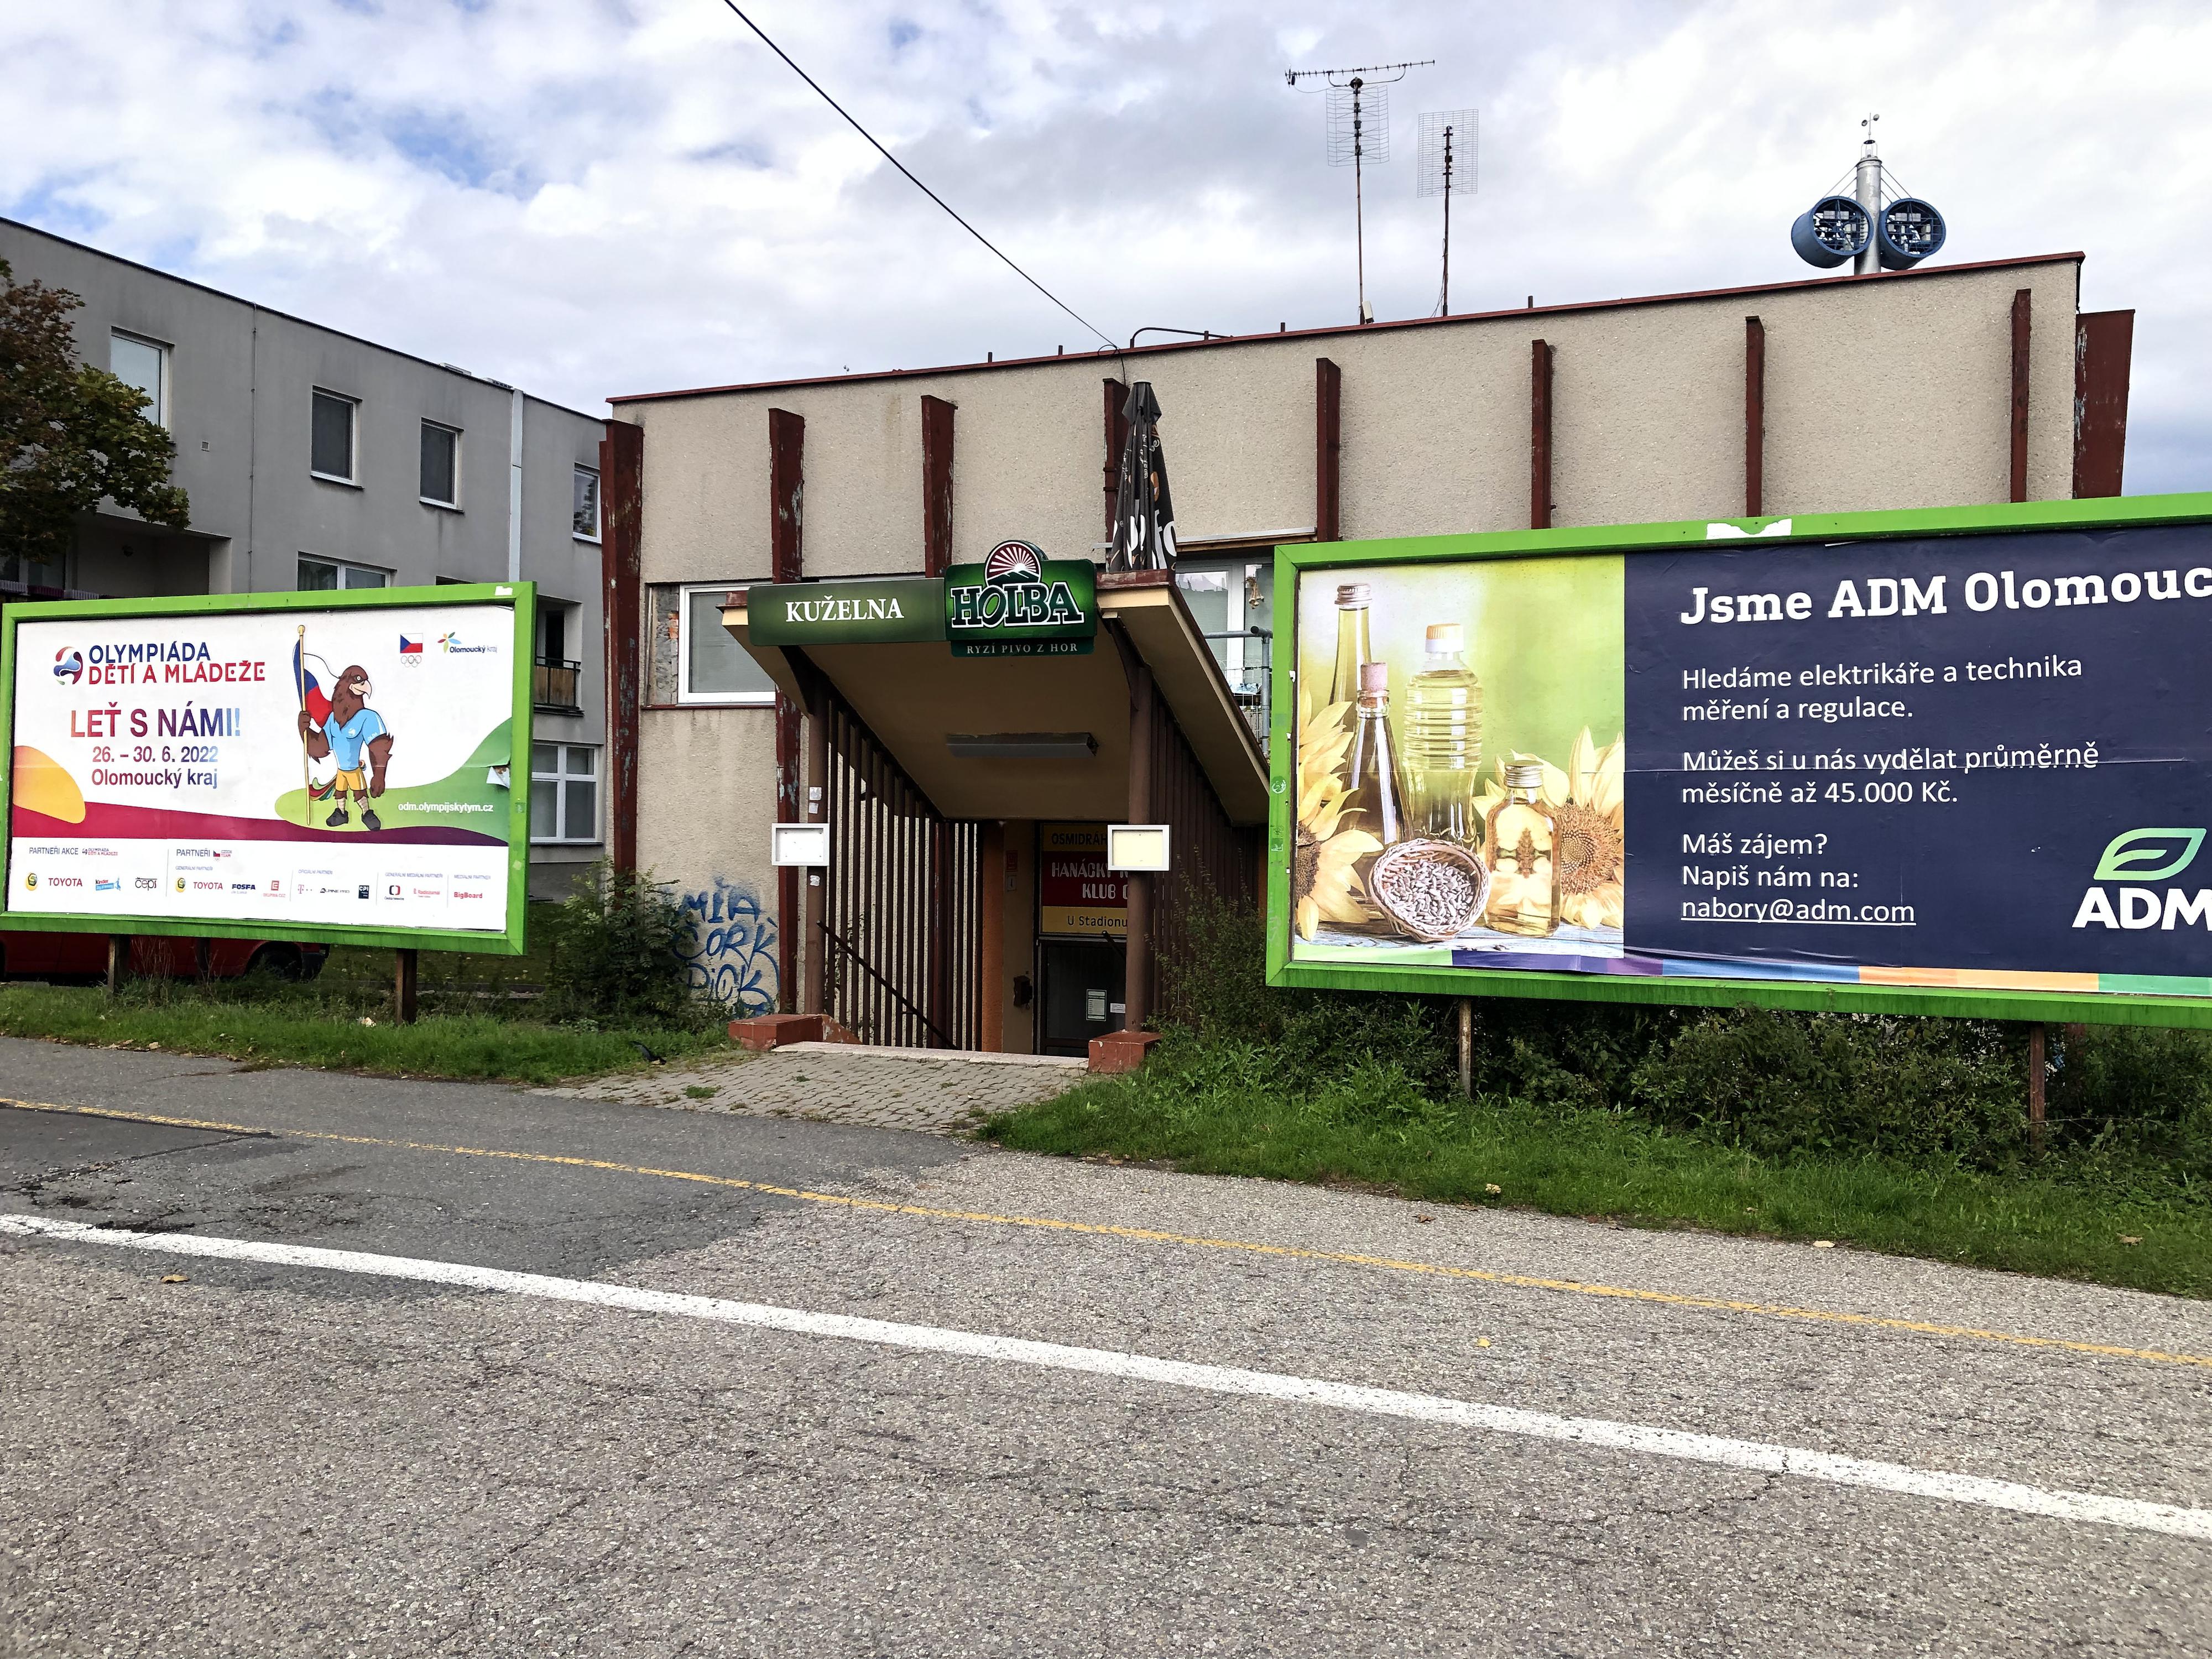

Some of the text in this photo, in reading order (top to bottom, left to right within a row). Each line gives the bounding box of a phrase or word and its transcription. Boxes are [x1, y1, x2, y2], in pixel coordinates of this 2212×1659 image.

[951, 582, 1084, 628] HOLBA
[1681, 567, 2212, 624] Jsme ADM Olomouc
[785, 594, 904, 623] KUŽELNA
[89, 640, 211, 663] OLYMPIÁDA
[450, 645, 486, 654] Olomoucký
[967, 643, 1078, 654] RYZÍ PIVO Z HOR
[89, 660, 265, 685] DĚTÍ A MLÁDEŽE
[1683, 655, 2083, 689] Hledáme elektrikáře a technika
[71, 701, 241, 737] LEŤ S NÁMI!
[1683, 696, 1913, 723] měření a regulace.
[92, 747, 114, 763] 26.
[133, 746, 156, 763] 30.
[162, 747, 175, 763] 6.
[181, 746, 218, 763] 2022
[1683, 741, 2099, 775] Můžeš si u nás vydělat průměrně
[91, 768, 217, 789] Olomoucký kraj
[1682, 780, 1958, 804] měsíčně až 45.000 Kč.
[398, 802, 494, 813] odm.olympijskytym.cz
[29, 846, 60, 854] PARTNEŘI
[176, 848, 210, 857] PARTNEŘI
[1683, 832, 1828, 859] Máš zájem?
[49, 878, 82, 886] TOYOTA
[1683, 865, 1859, 890] Napiš nám na:
[1082, 883, 1116, 899] KLUB
[1068, 916, 1074, 925] U
[1682, 896, 1915, 924] nabory@adm.com
[2072, 886, 2212, 931] ADM
